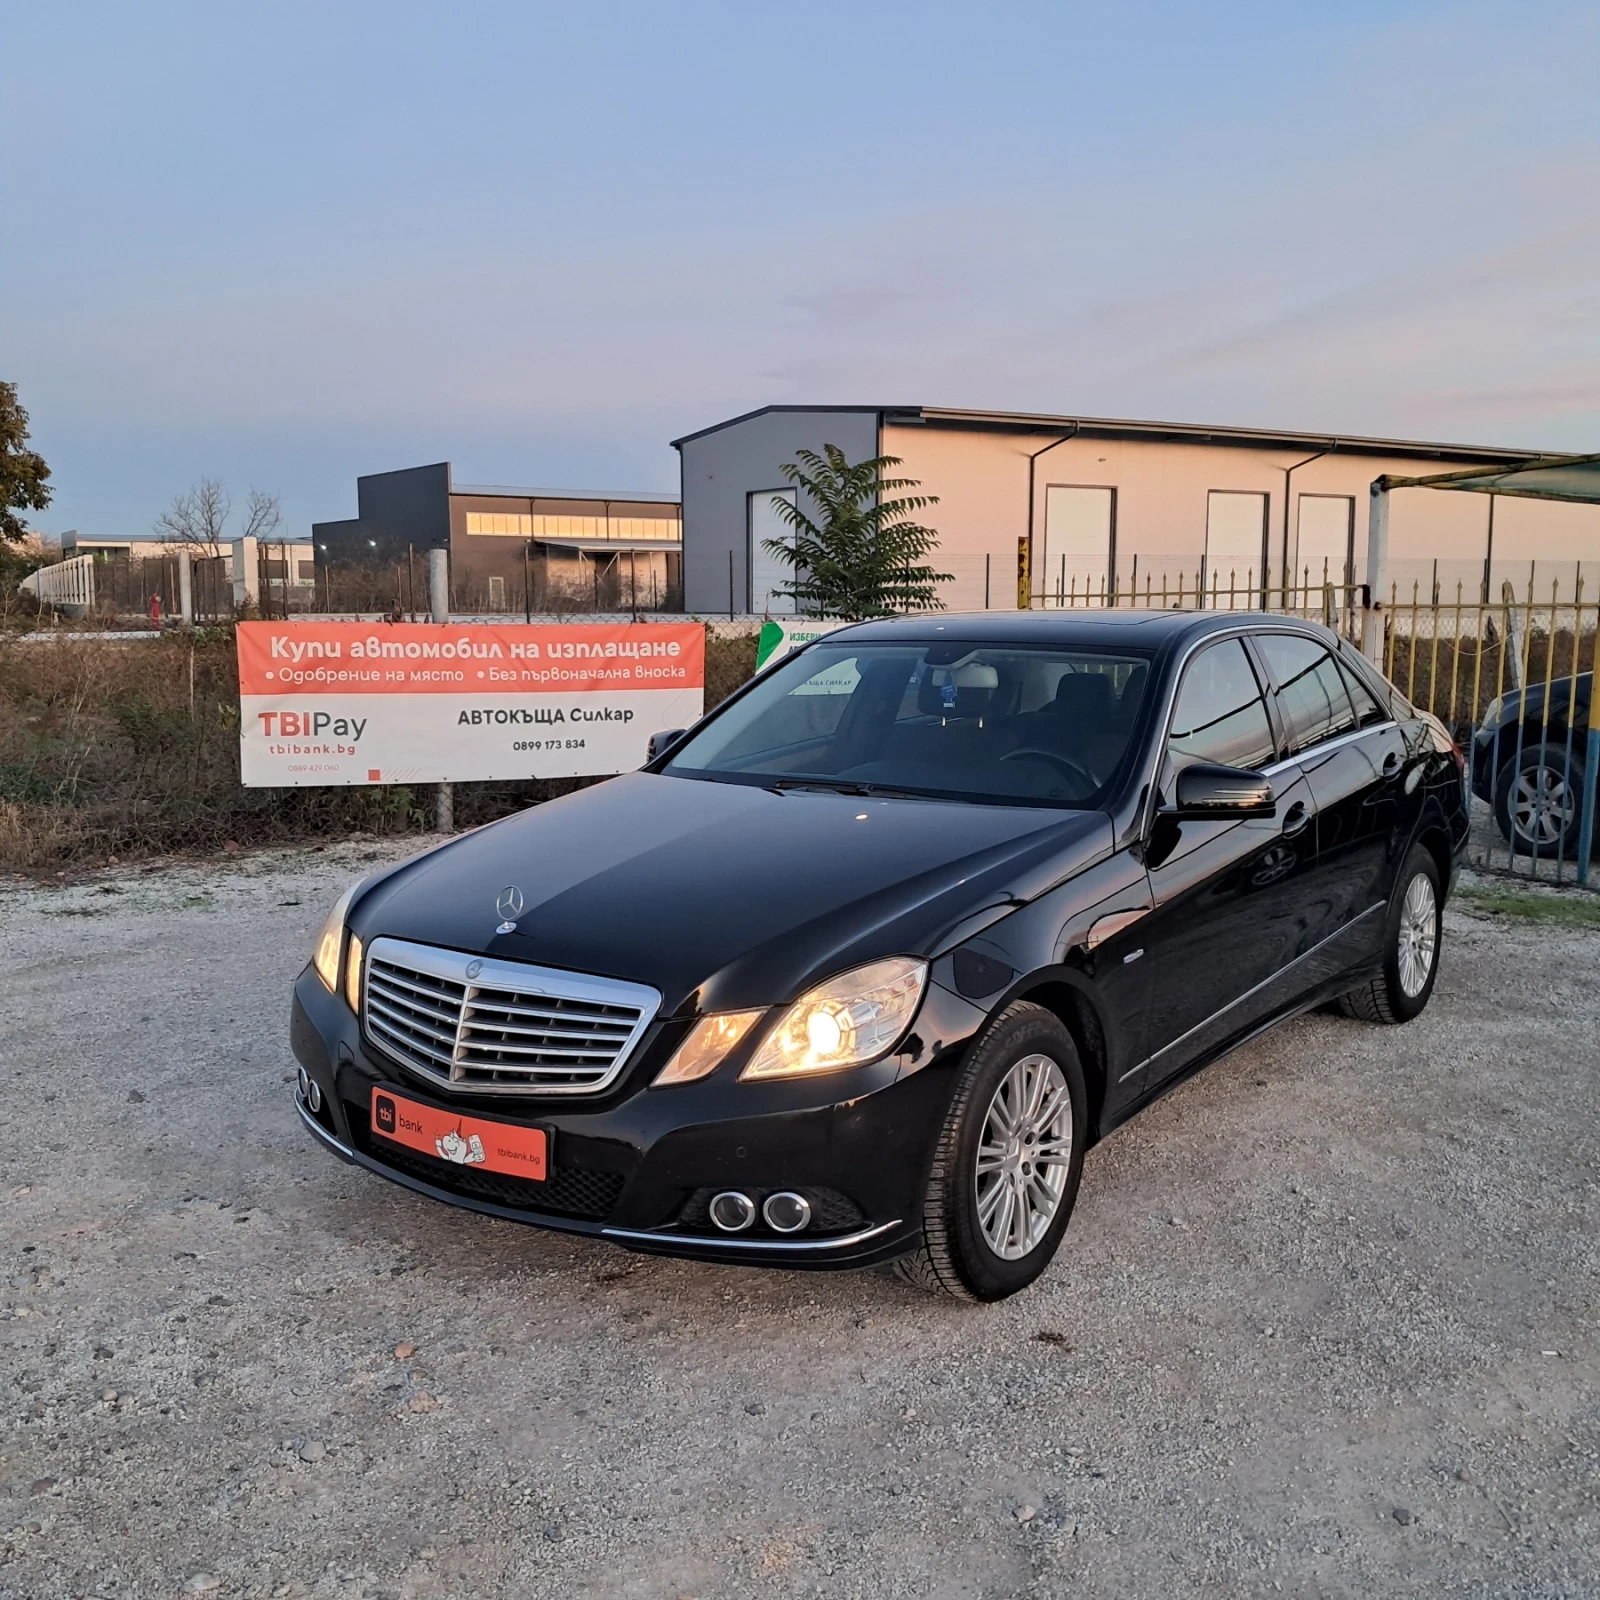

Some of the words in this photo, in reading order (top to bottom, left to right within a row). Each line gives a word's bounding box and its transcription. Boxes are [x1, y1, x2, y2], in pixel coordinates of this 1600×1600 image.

[271, 636, 341, 663] Купи
[350, 636, 504, 659] автомобил
[510, 643, 540, 659] на
[547, 641, 681, 660] изплащане
[279, 667, 381, 684] Одобрение
[386, 670, 405, 681] на
[410, 670, 464, 681] място
[489, 667, 517, 681] Без
[522, 667, 631, 683] първоначална
[635, 664, 686, 679] вноска
[457, 709, 566, 725] АВТОКЪЩА
[570, 707, 635, 723] Силкар
[258, 712, 368, 742] TBIPay
[269, 744, 356, 755] tbibank.bg
[512, 741, 542, 751] 0899
[545, 740, 562, 750] 173
[565, 739, 586, 749] 834
[309, 764, 323, 772] 429
[379, 1107, 392, 1123] tbi
[399, 1114, 424, 1135] bank
[497, 1147, 541, 1165] tbibank.bg
